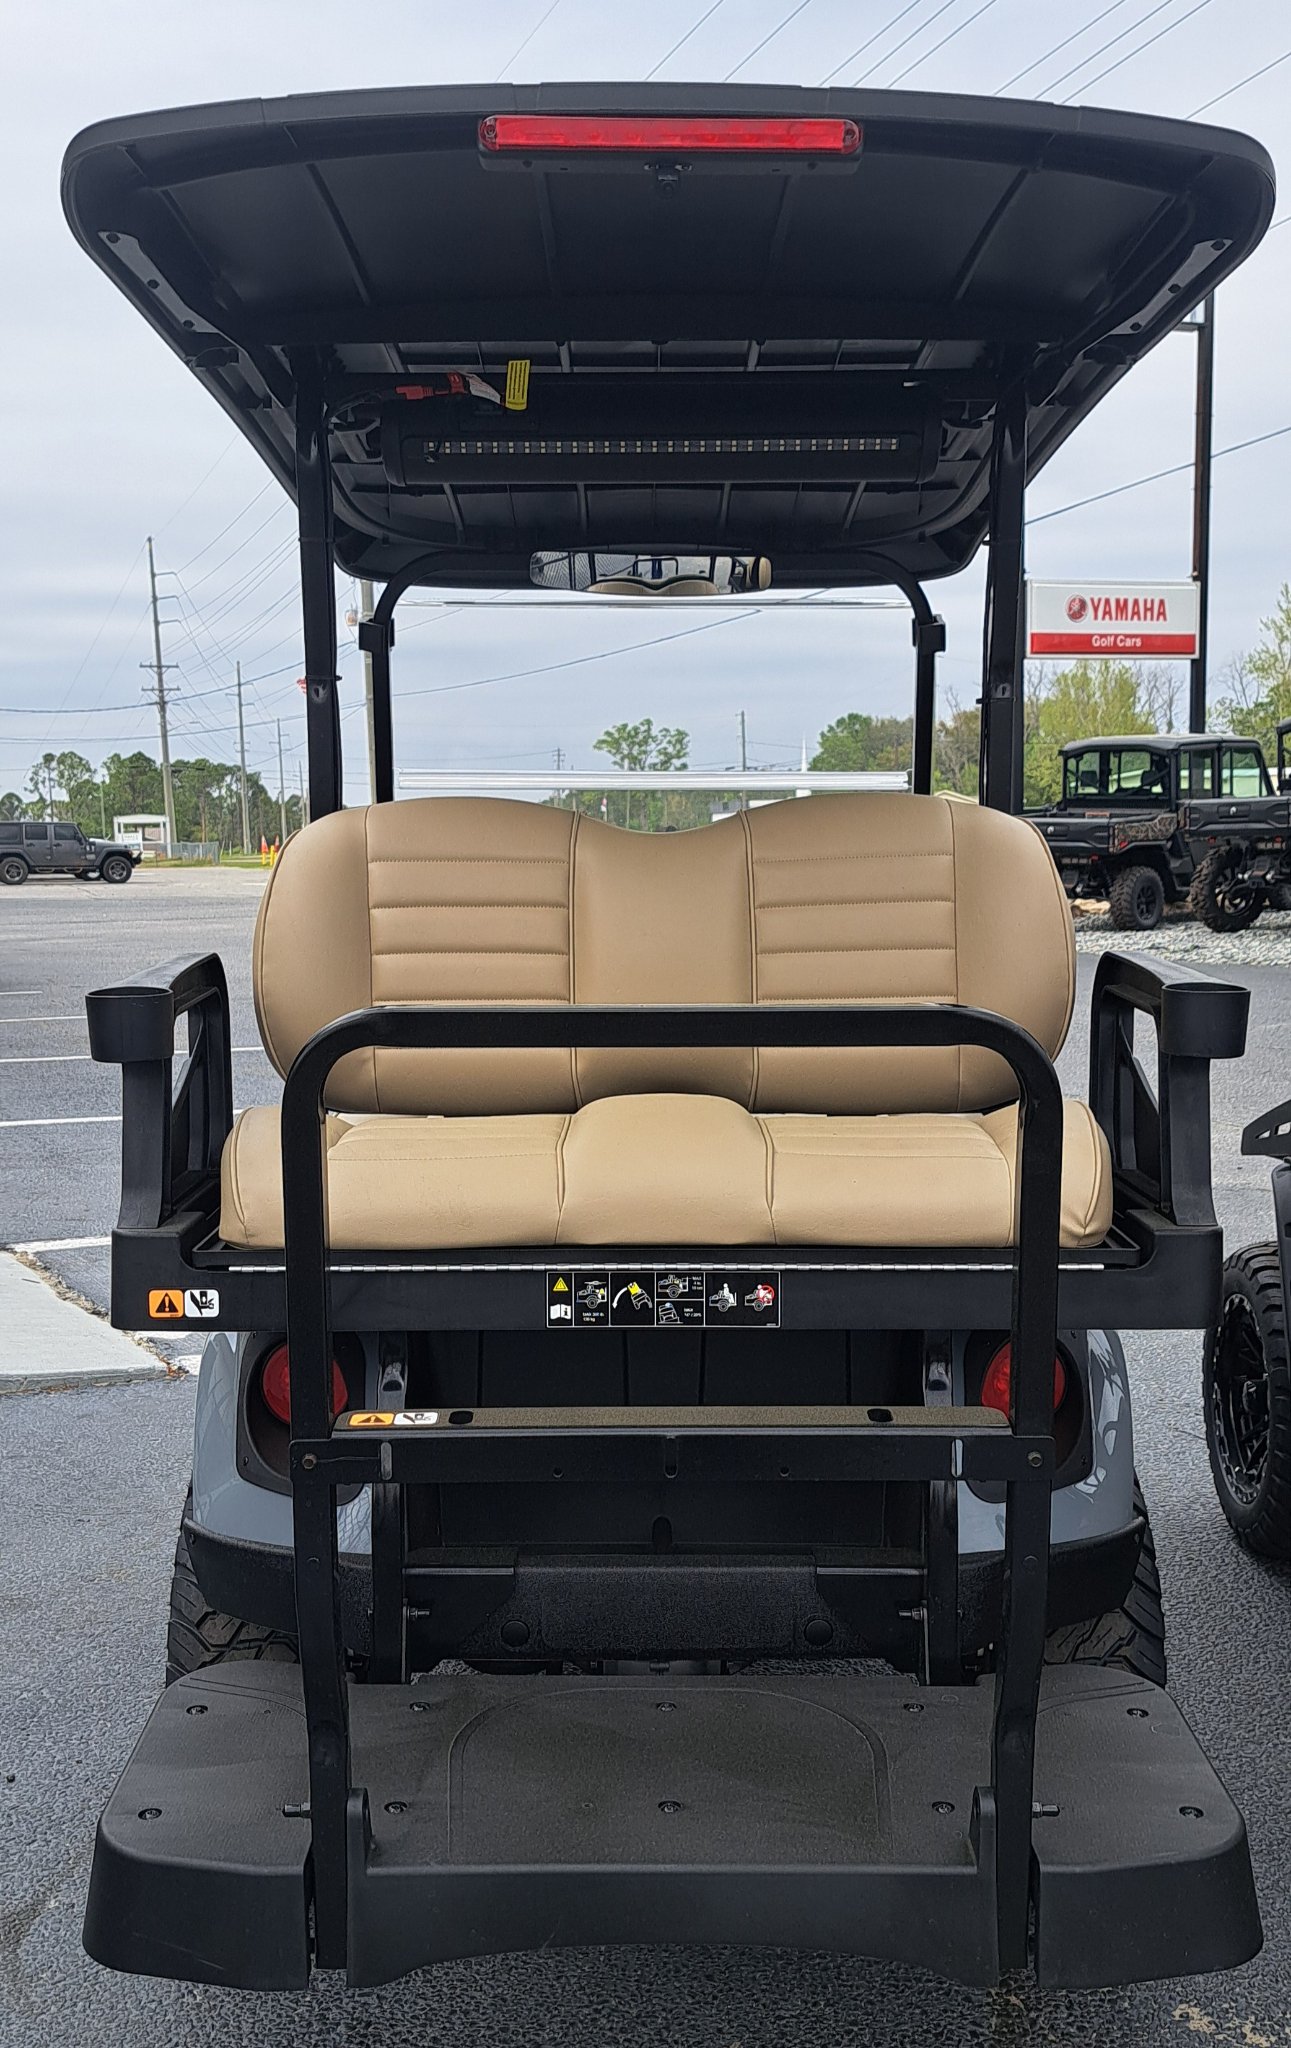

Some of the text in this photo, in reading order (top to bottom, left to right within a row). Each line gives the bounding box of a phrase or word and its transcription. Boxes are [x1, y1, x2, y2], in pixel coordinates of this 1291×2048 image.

[1090, 597, 1167, 622] YAMAHA
[1091, 635, 1142, 648] Golf Cars
